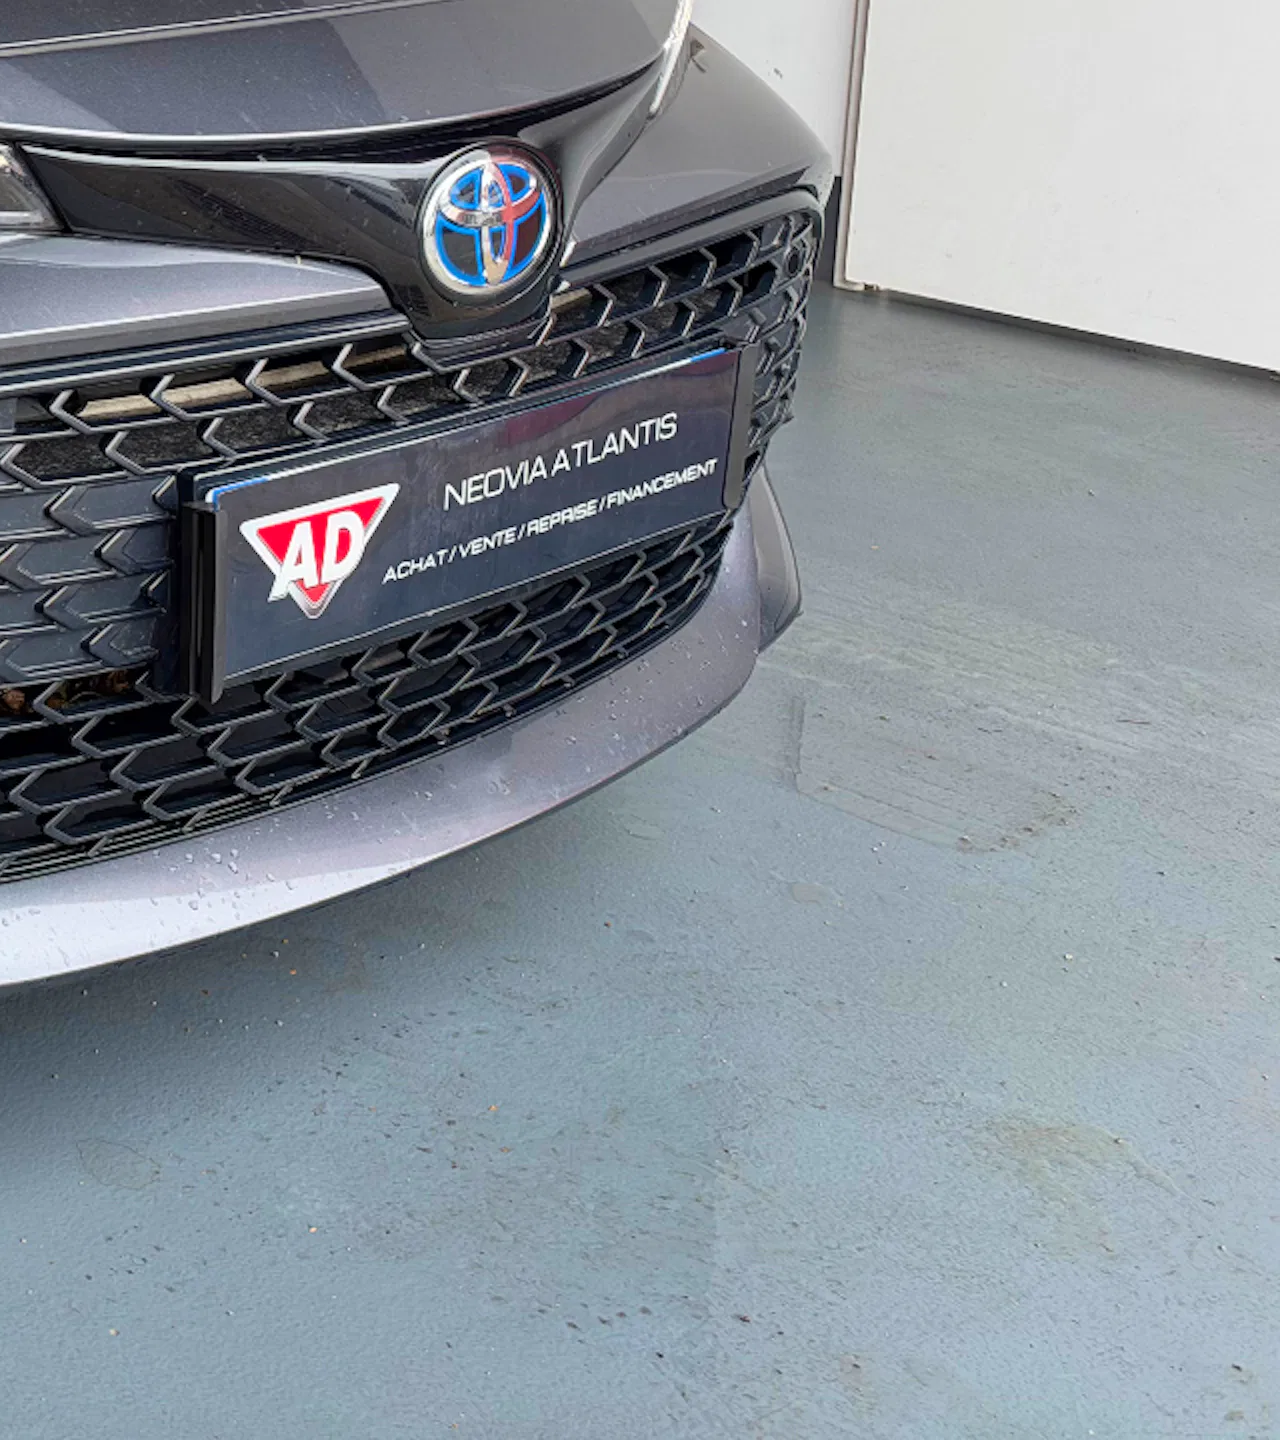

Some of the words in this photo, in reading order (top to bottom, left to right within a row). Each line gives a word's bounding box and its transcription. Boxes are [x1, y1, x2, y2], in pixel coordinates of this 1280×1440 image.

[443, 455, 547, 511] NEOVIA
[551, 412, 678, 477] ATLANTIS
[459, 526, 517, 558] VENTE
[526, 498, 599, 537] REPRISE
[606, 458, 719, 509] FINANCEMENT
[268, 509, 366, 602] AD
